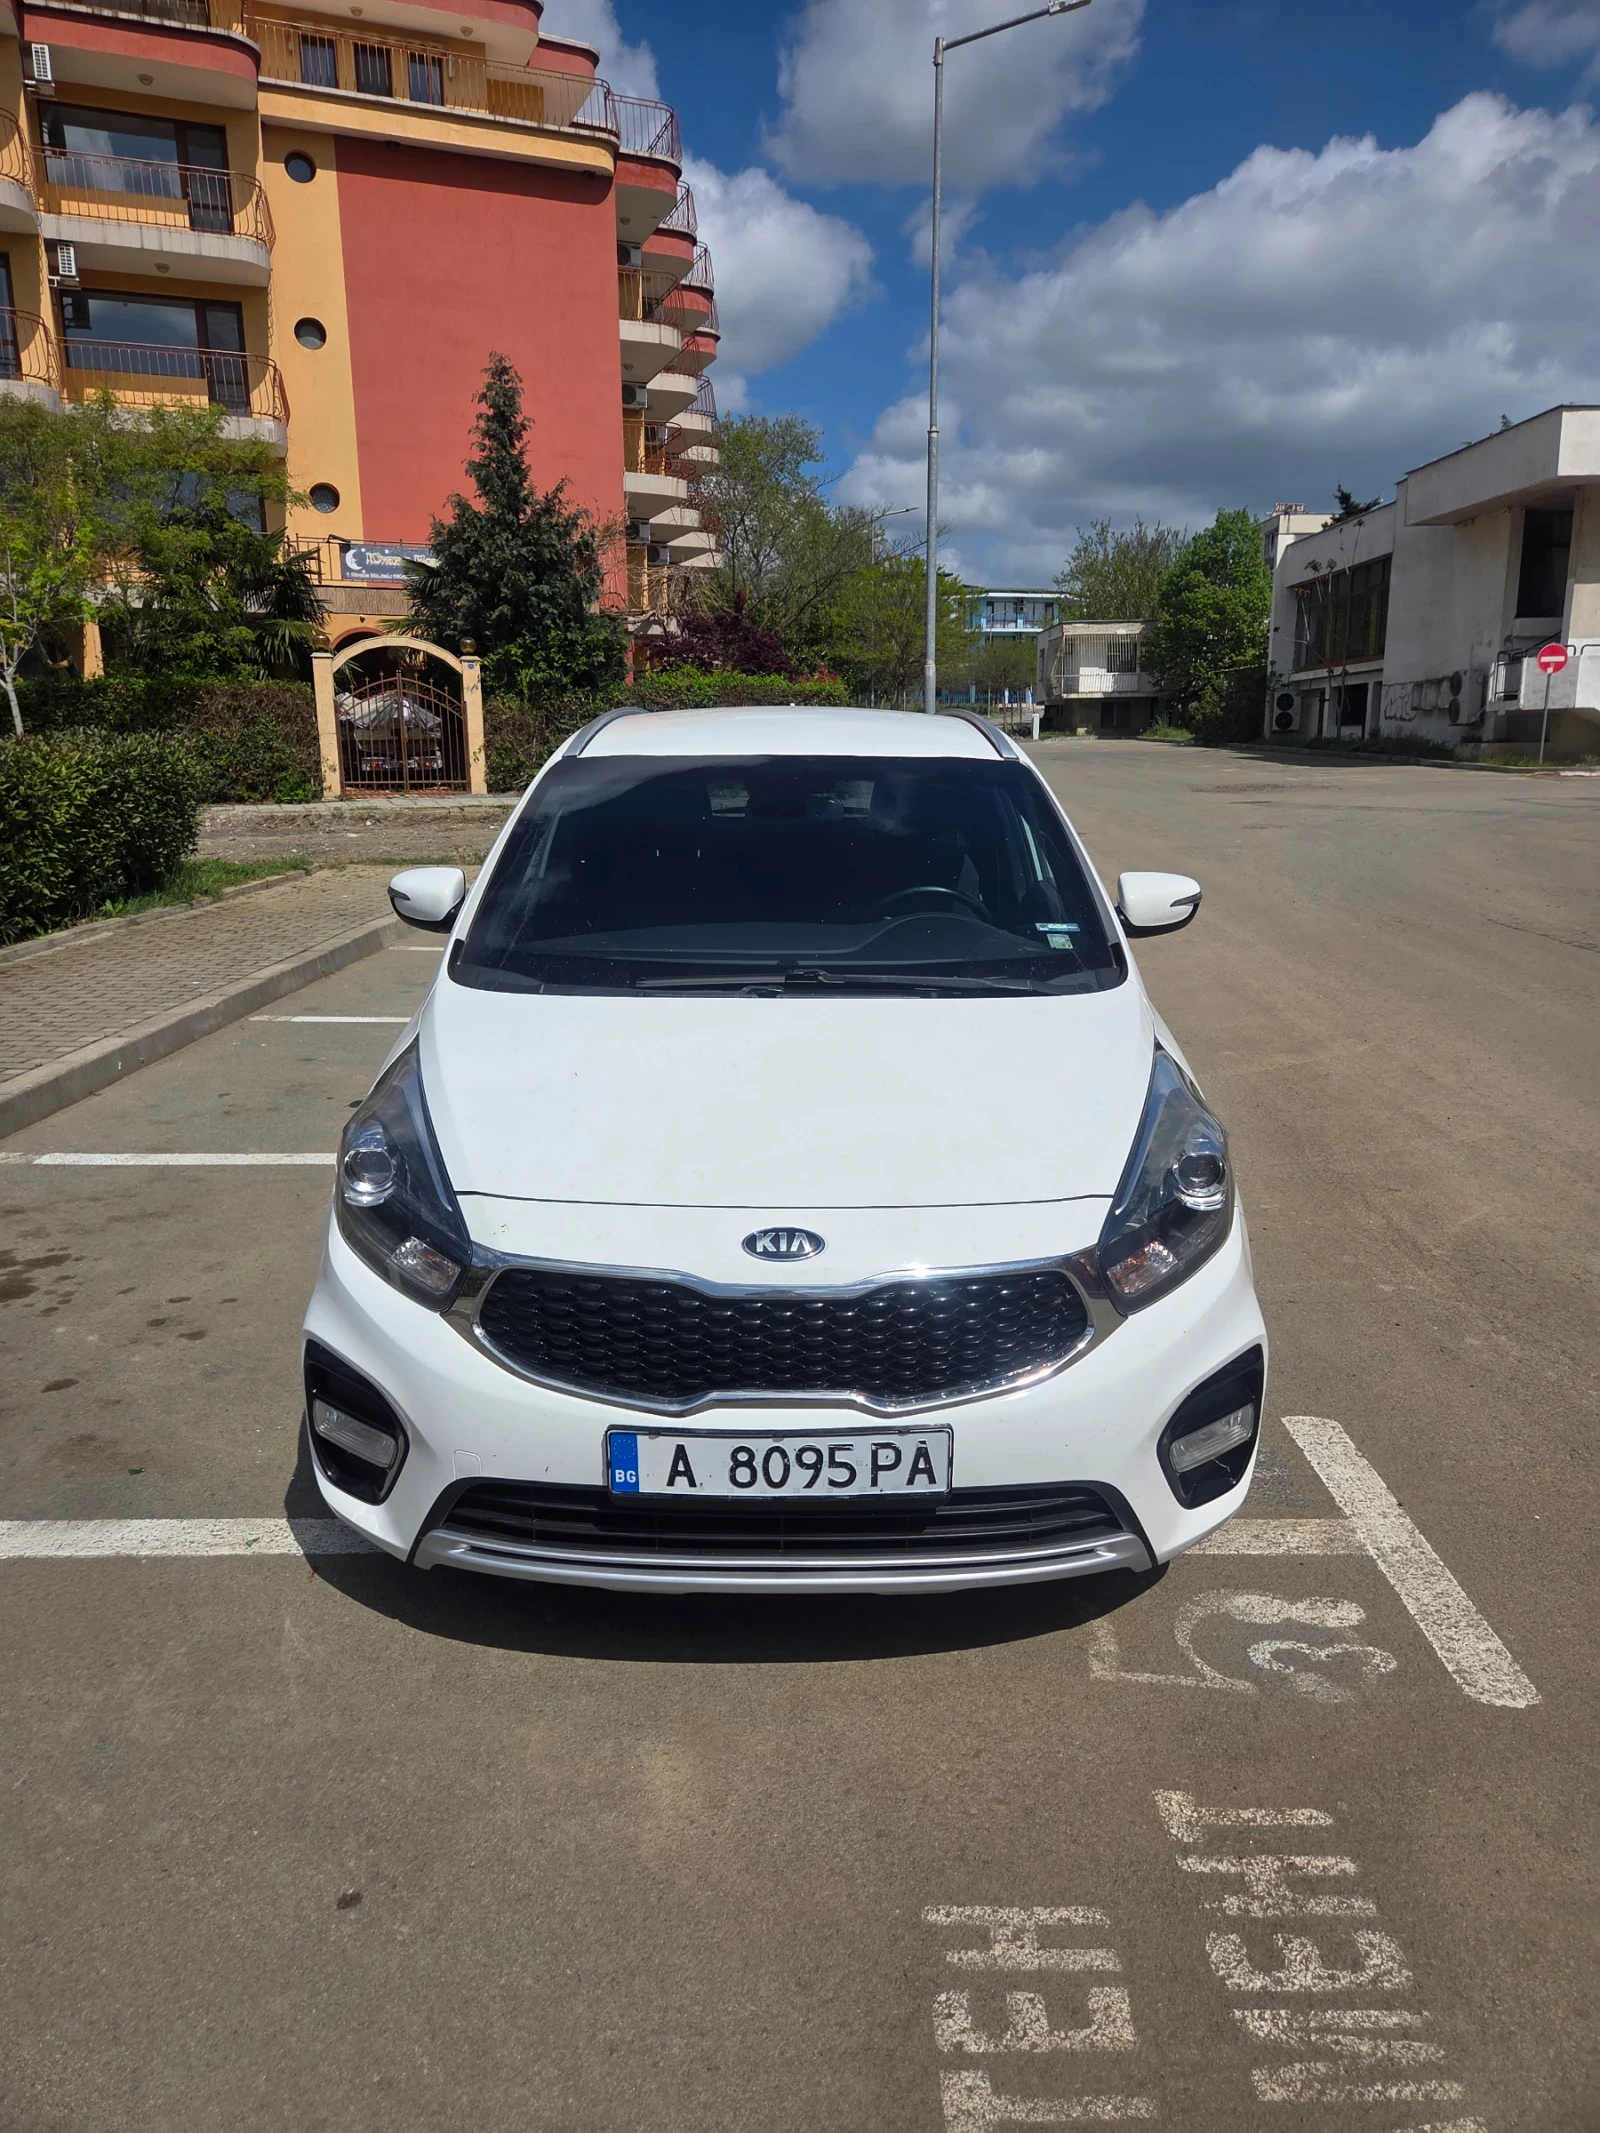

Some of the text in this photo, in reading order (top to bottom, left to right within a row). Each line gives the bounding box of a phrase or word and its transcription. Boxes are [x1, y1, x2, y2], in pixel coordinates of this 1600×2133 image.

[756, 1232, 814, 1253] KIA
[614, 1469, 637, 1484] BG
[666, 1443, 698, 1488] A
[728, 1441, 857, 1490] 8095
[1151, 1788, 1489, 2133] МЕНТ
